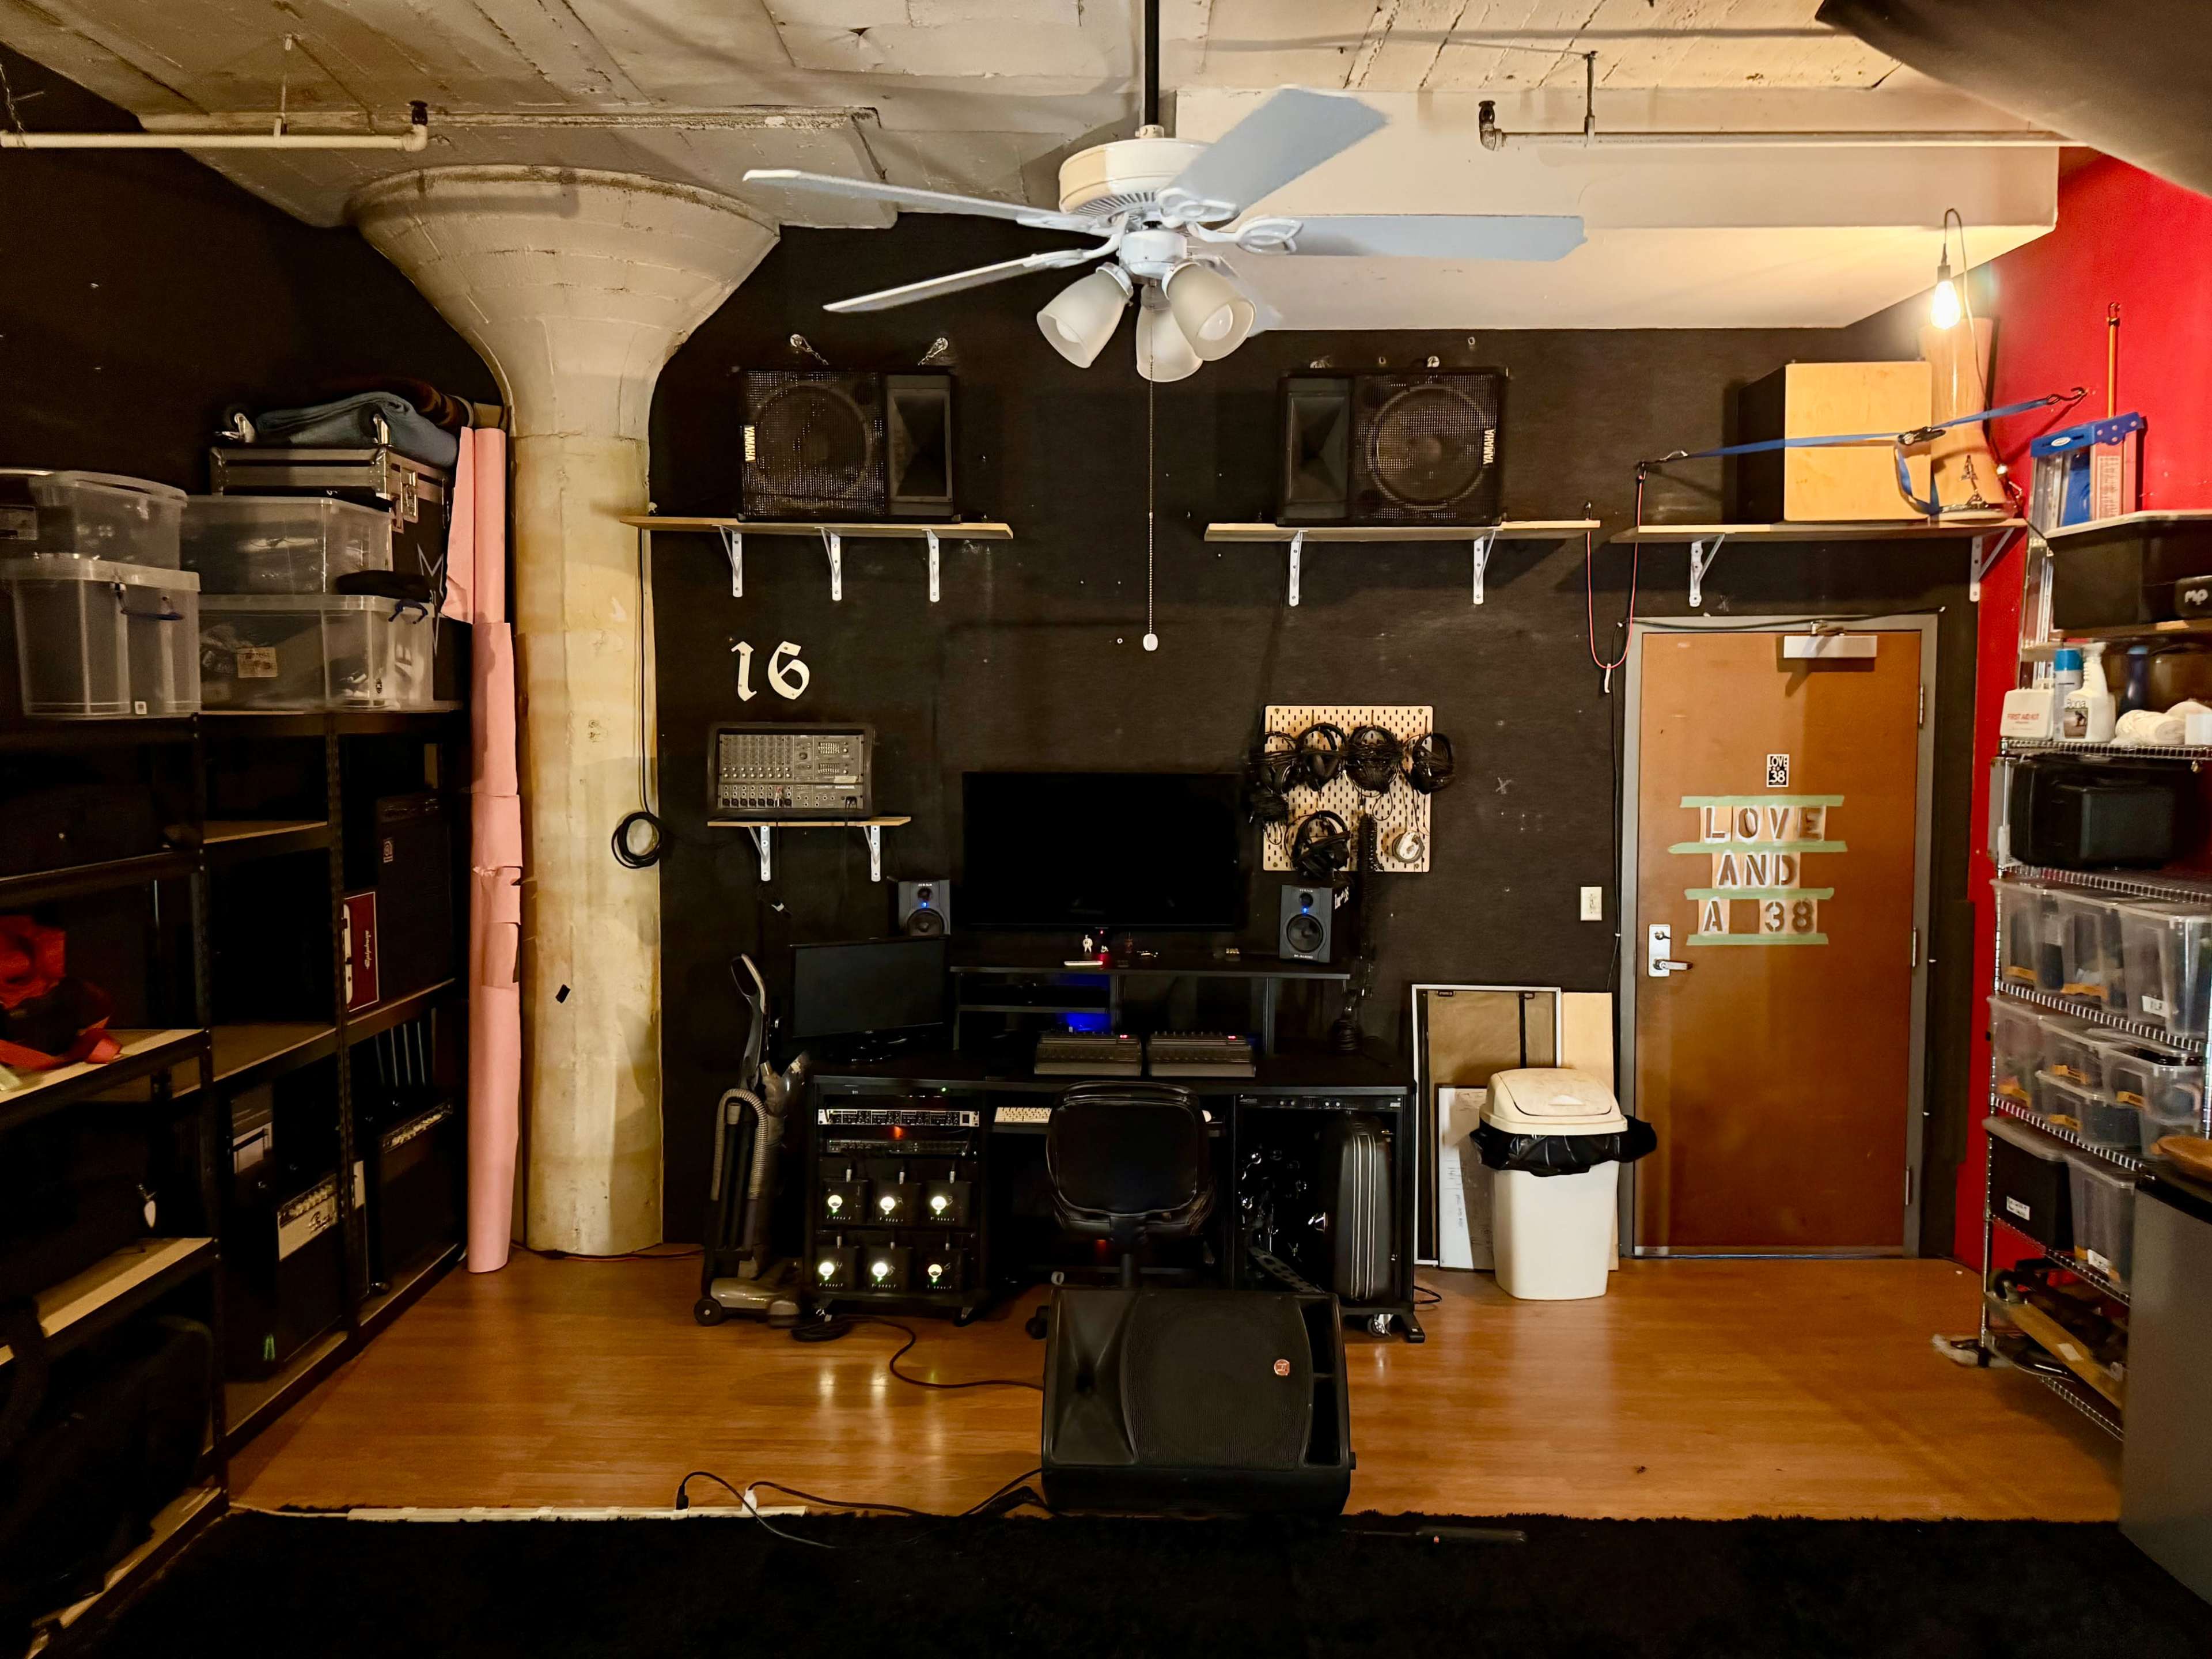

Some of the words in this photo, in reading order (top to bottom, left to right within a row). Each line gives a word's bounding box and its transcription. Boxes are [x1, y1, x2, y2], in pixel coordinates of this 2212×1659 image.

[744, 426, 756, 461] YAMAHA
[1483, 429, 1494, 464] YAMAHA
[731, 641, 810, 702] 16
[1768, 755, 1787, 767] LOVE
[1769, 770, 1785, 783] 38
[1703, 806, 1824, 841] LOVE
[1717, 853, 1798, 887] AND
[1703, 899, 1724, 933] A
[1764, 899, 1815, 933] 38
